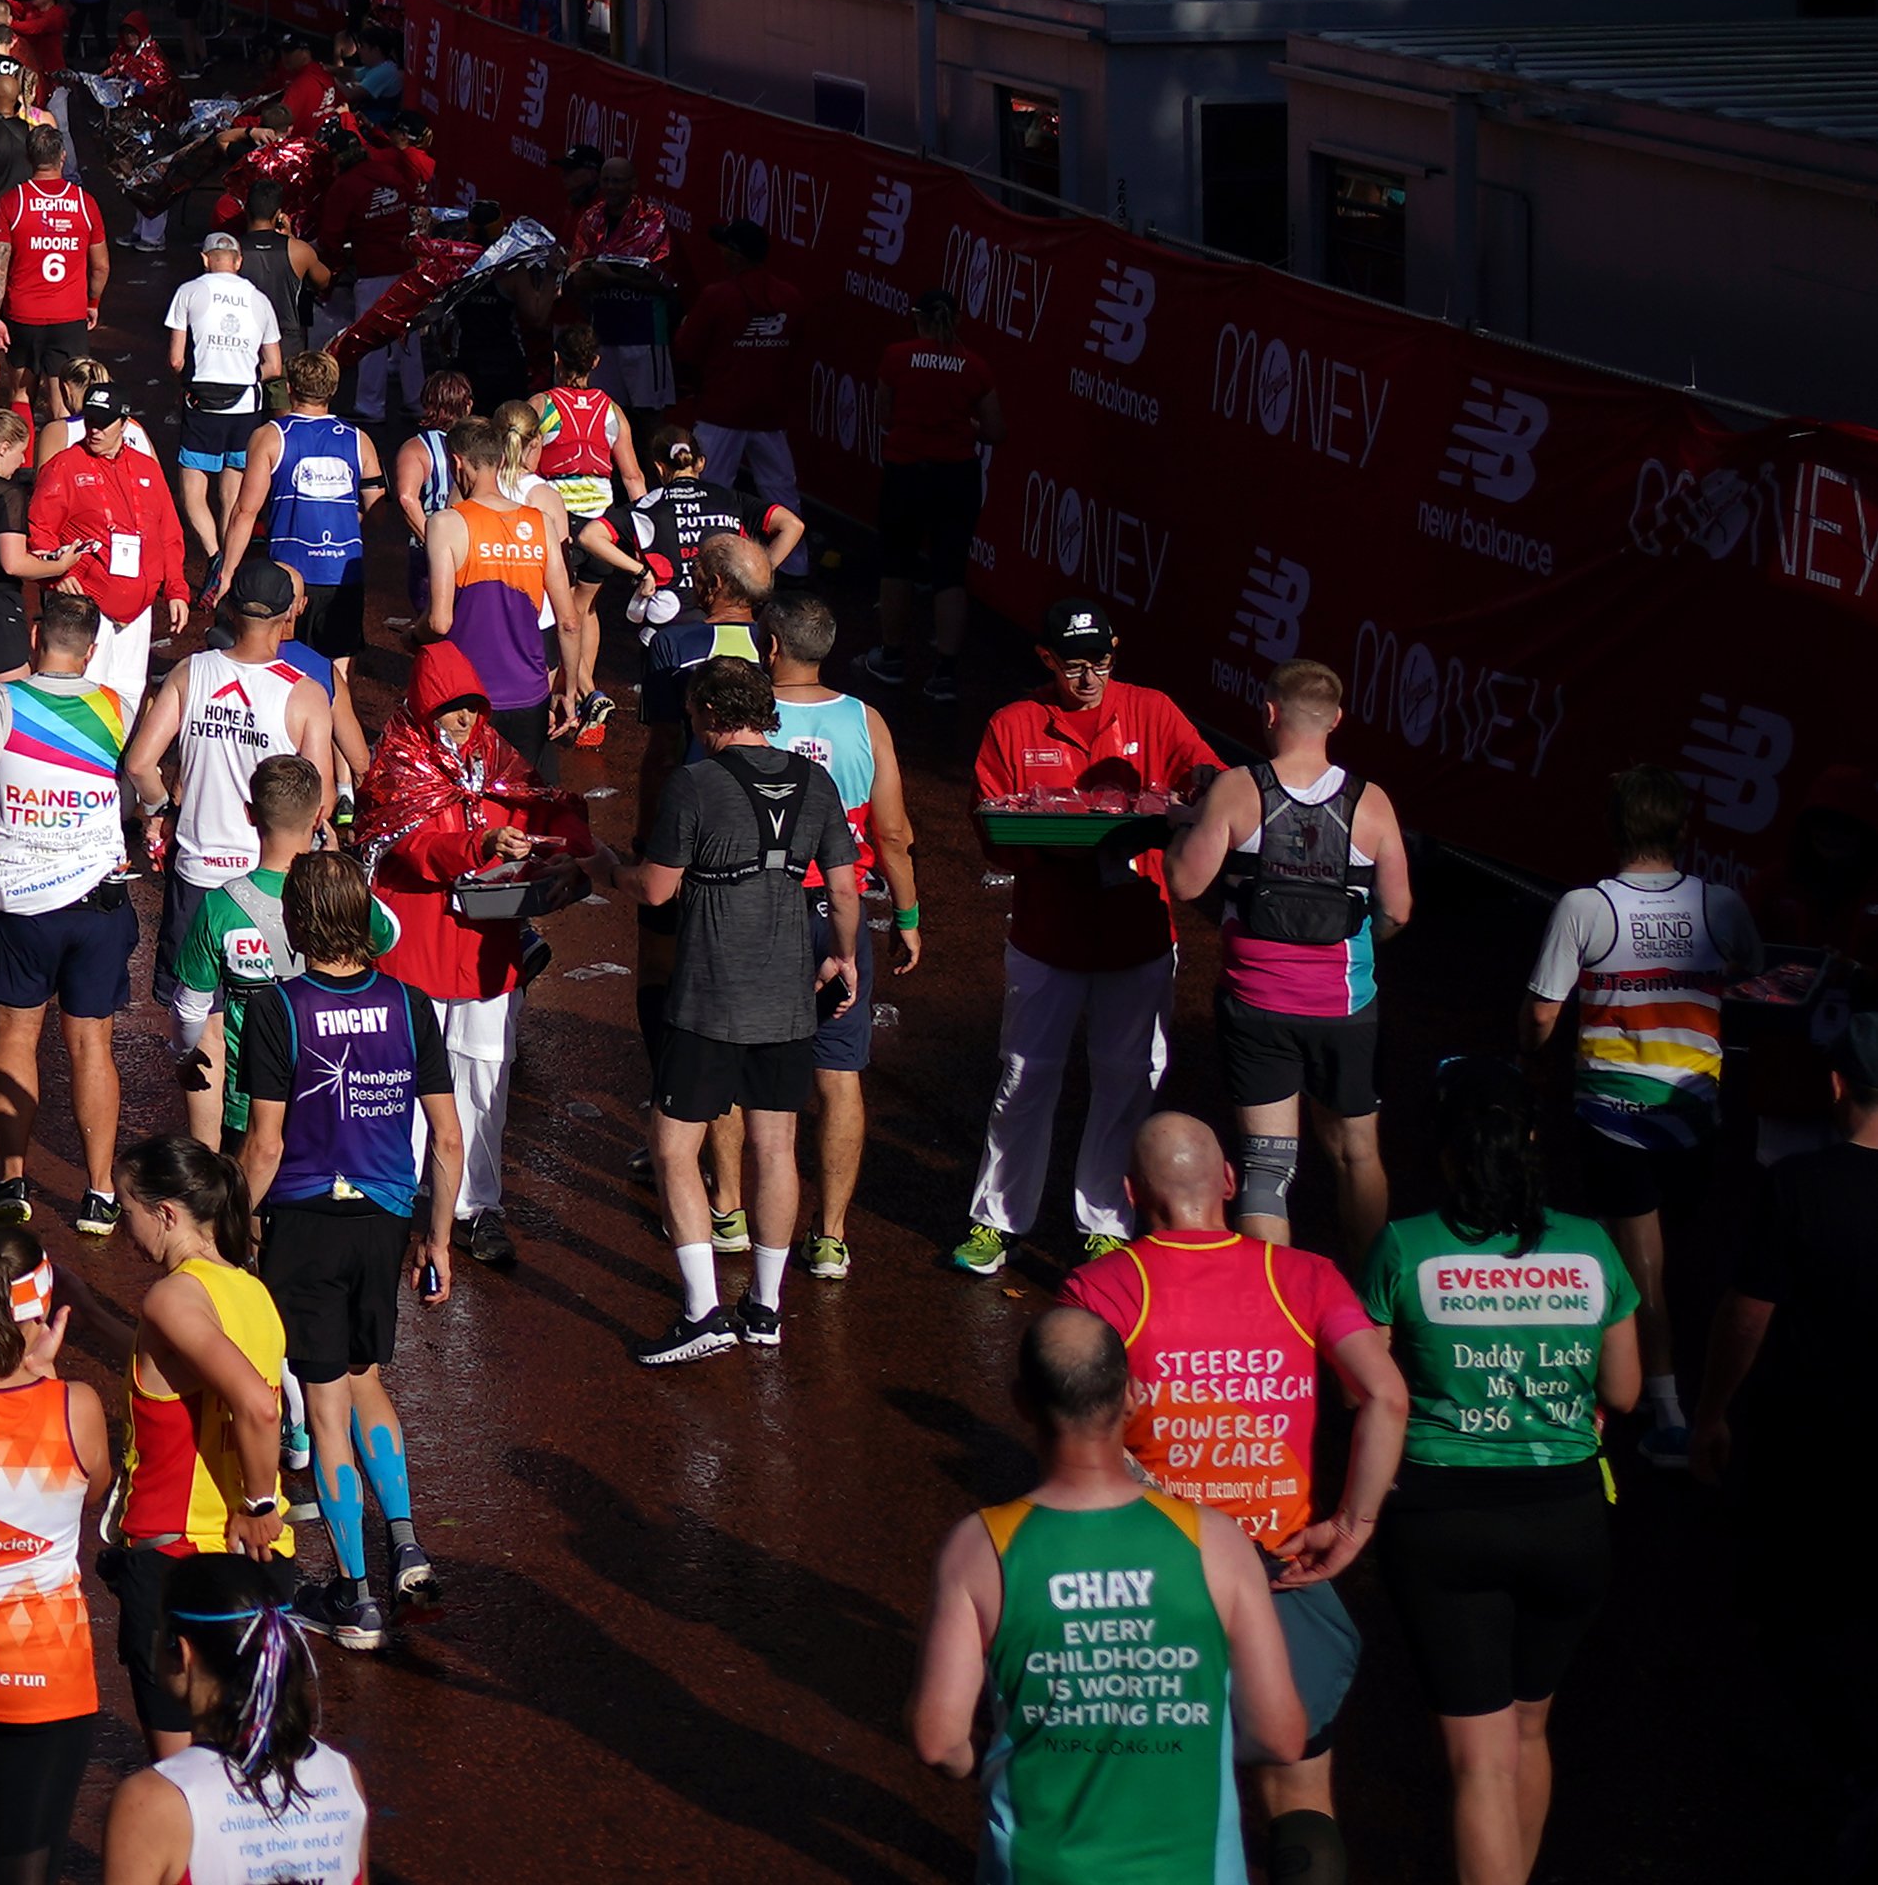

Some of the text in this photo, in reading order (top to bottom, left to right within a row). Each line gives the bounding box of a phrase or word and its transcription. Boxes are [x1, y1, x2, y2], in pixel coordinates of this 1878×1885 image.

[29, 197, 79, 213] LEIGHTON
[30, 237, 80, 251] MOORE
[42, 252, 66, 283] 6
[213, 293, 249, 308] PAUL
[846, 267, 910, 315] new balance
[910, 352, 966, 373] NORWAY
[1069, 365, 1159, 427] new balance
[675, 502, 701, 514] I'M
[676, 515, 740, 530] PUTTING
[677, 531, 702, 544] MY
[1417, 499, 1554, 577] new balance
[479, 542, 544, 559] sense
[204, 704, 256, 729] HOME IS
[191, 720, 269, 749] EVERYTHING
[5, 784, 118, 808] RAINBOW
[6, 804, 90, 829] TRUST
[203, 856, 250, 868] SHELTER
[1630, 921, 1694, 940] BLIND
[1632, 939, 1694, 951] CHILDREN
[315, 1006, 388, 1037] FINCHY
[1437, 1266, 1591, 1292] EVERYONE.
[1439, 1293, 1590, 1312] FROM DAY ONE
[1154, 1348, 1285, 1376] STEERED
[1453, 1341, 1593, 1371] Daddy Lacks
[1170, 1375, 1314, 1403] RESEARCH
[1487, 1375, 1570, 1399] My hero
[1151, 1415, 1290, 1442] POWERED
[1457, 1406, 1511, 1431] 1956
[1168, 1440, 1287, 1468] BY CARE
[1205, 1478, 1253, 1501] memory
[1255, 1475, 1269, 1498] of
[1271, 1478, 1299, 1496] mum
[1049, 1569, 1154, 1611] CHAY
[1063, 1619, 1154, 1646] EVERY
[1026, 1646, 1201, 1673] CHILDHOOD
[14, 1674, 47, 1688] run
[1047, 1672, 1183, 1700] IS WORTH
[1022, 1701, 1211, 1728] FIGHTING FOR
[314, 1810, 351, 1823] cancer
[266, 1834, 300, 1853] their
[303, 1834, 325, 1849] end
[329, 1833, 344, 1849] of
[311, 1857, 342, 1873] bell
